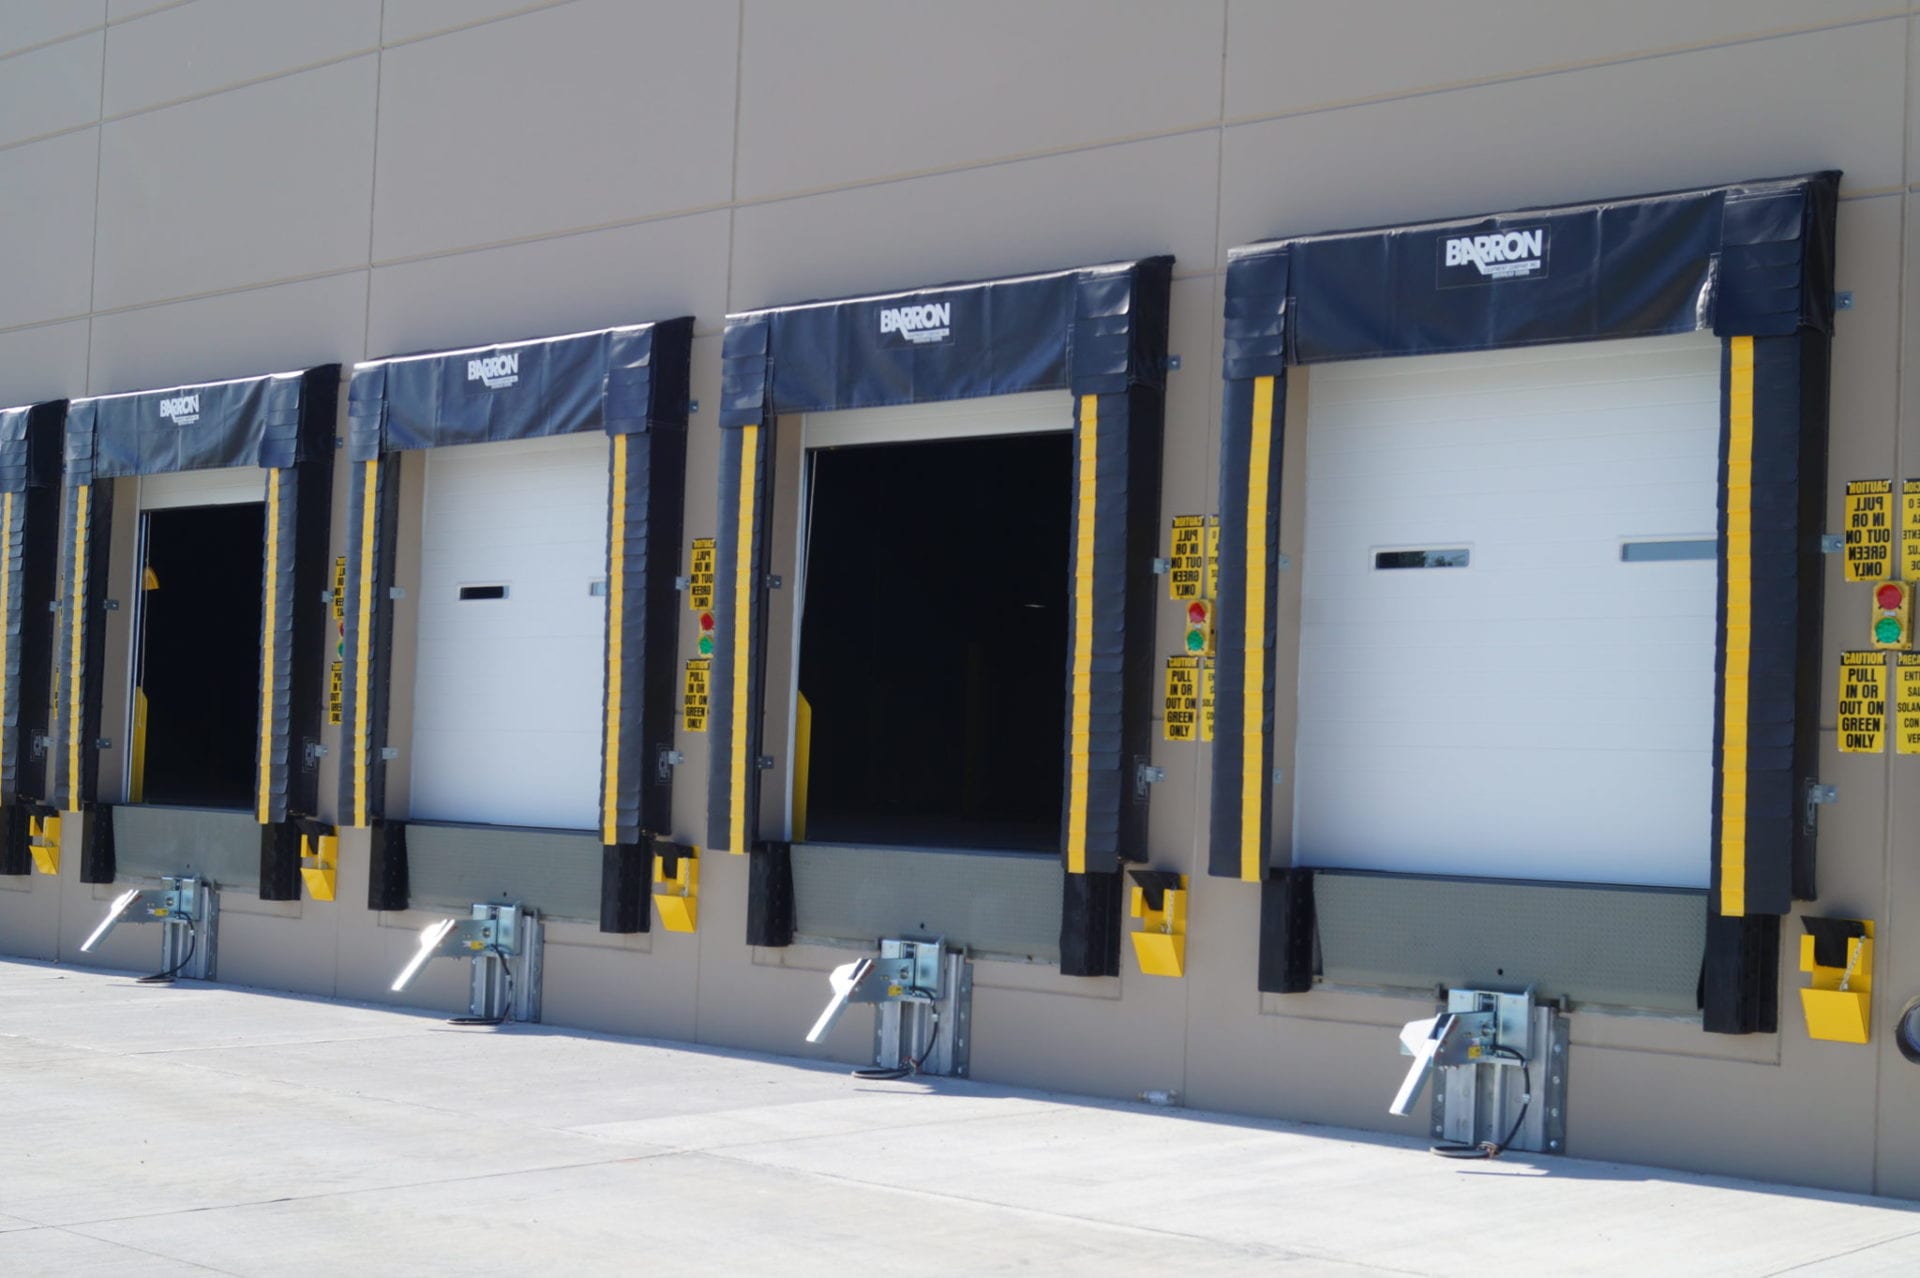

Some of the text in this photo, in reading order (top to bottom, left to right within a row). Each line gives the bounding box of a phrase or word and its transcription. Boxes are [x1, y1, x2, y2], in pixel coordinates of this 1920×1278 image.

[1445, 229, 1543, 270] BARRON
[880, 302, 950, 336] BARRON
[467, 353, 519, 383] BARRON
[160, 394, 200, 420] BARRON
[1171, 670, 1192, 682] PULL
[1848, 668, 1877, 682] PULL
[1170, 683, 1193, 696] IN OR
[1845, 684, 1878, 699] IN OR
[1166, 697, 1197, 709] OUT ON
[1840, 700, 1884, 715] OUT ON
[1167, 711, 1194, 723] GREEN
[1842, 717, 1880, 732] GREEN
[1169, 724, 1190, 737] ONLY
[1846, 733, 1875, 748] ONLY
